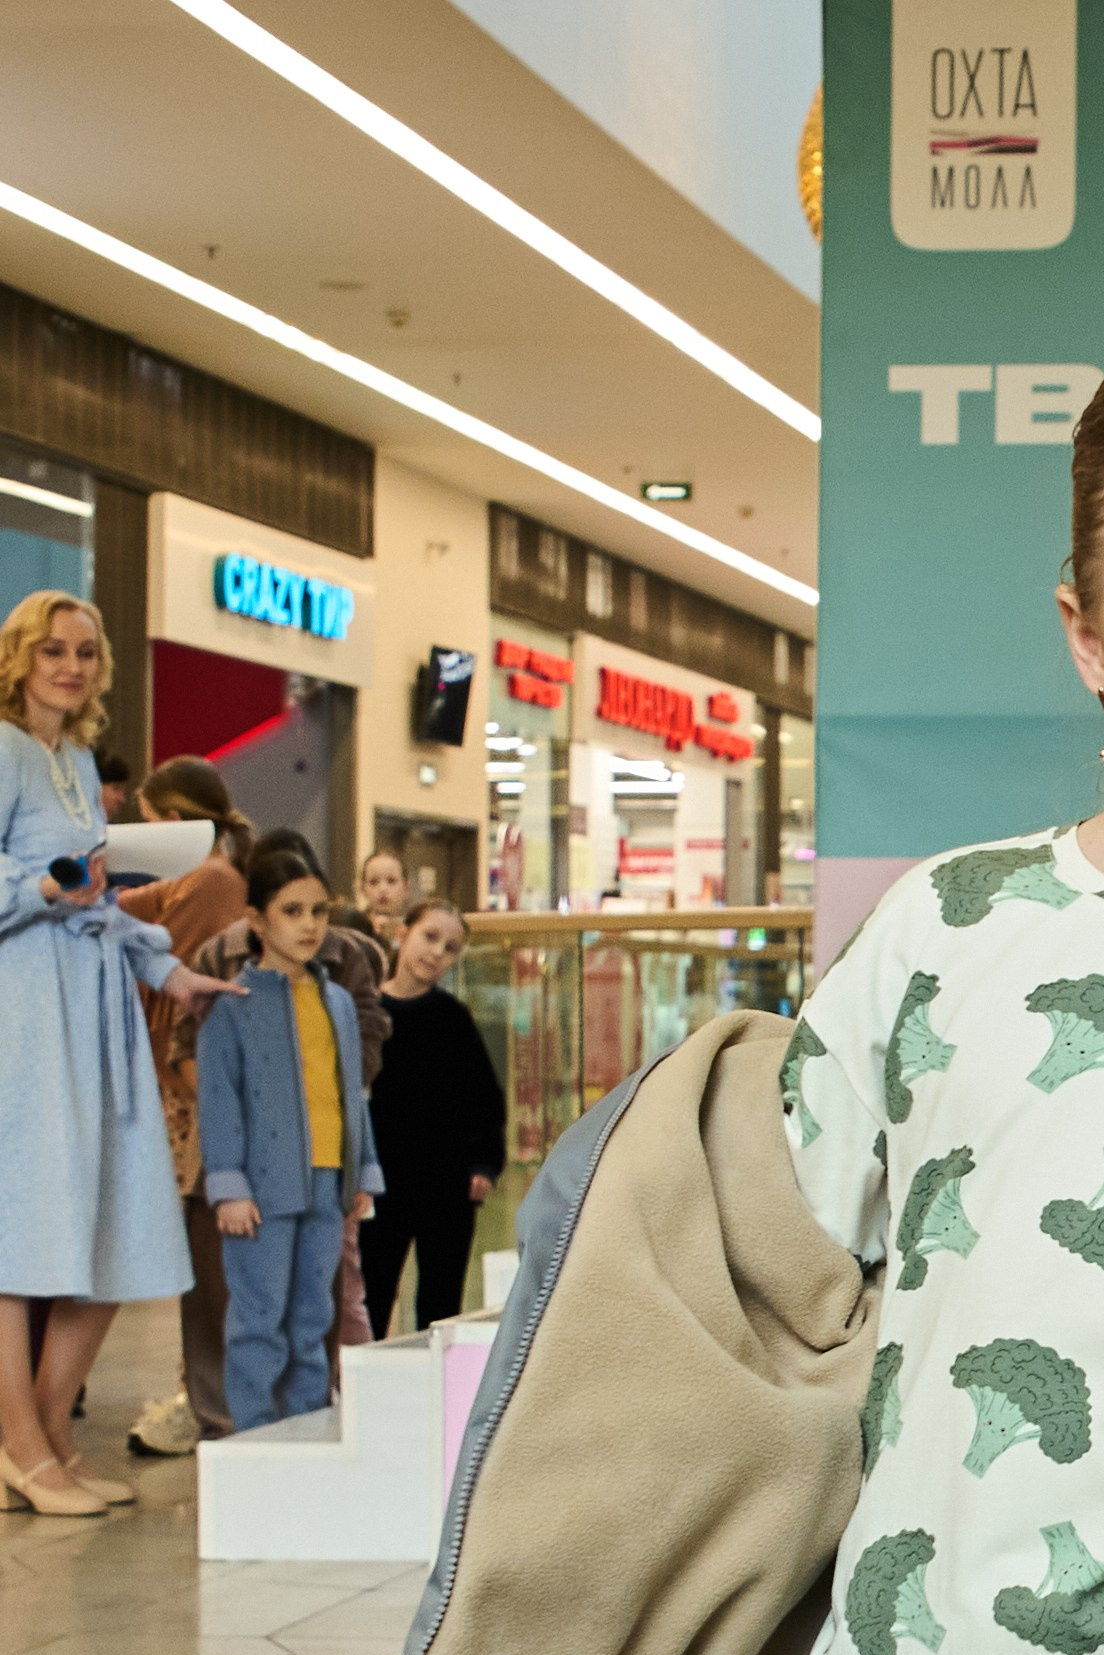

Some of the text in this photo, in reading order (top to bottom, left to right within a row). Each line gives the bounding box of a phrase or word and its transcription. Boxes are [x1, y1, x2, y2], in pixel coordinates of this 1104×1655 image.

[930, 47, 1038, 119] ОХТА
[888, 363, 1104, 445] ТВ
[214, 551, 306, 630] CRAZY
